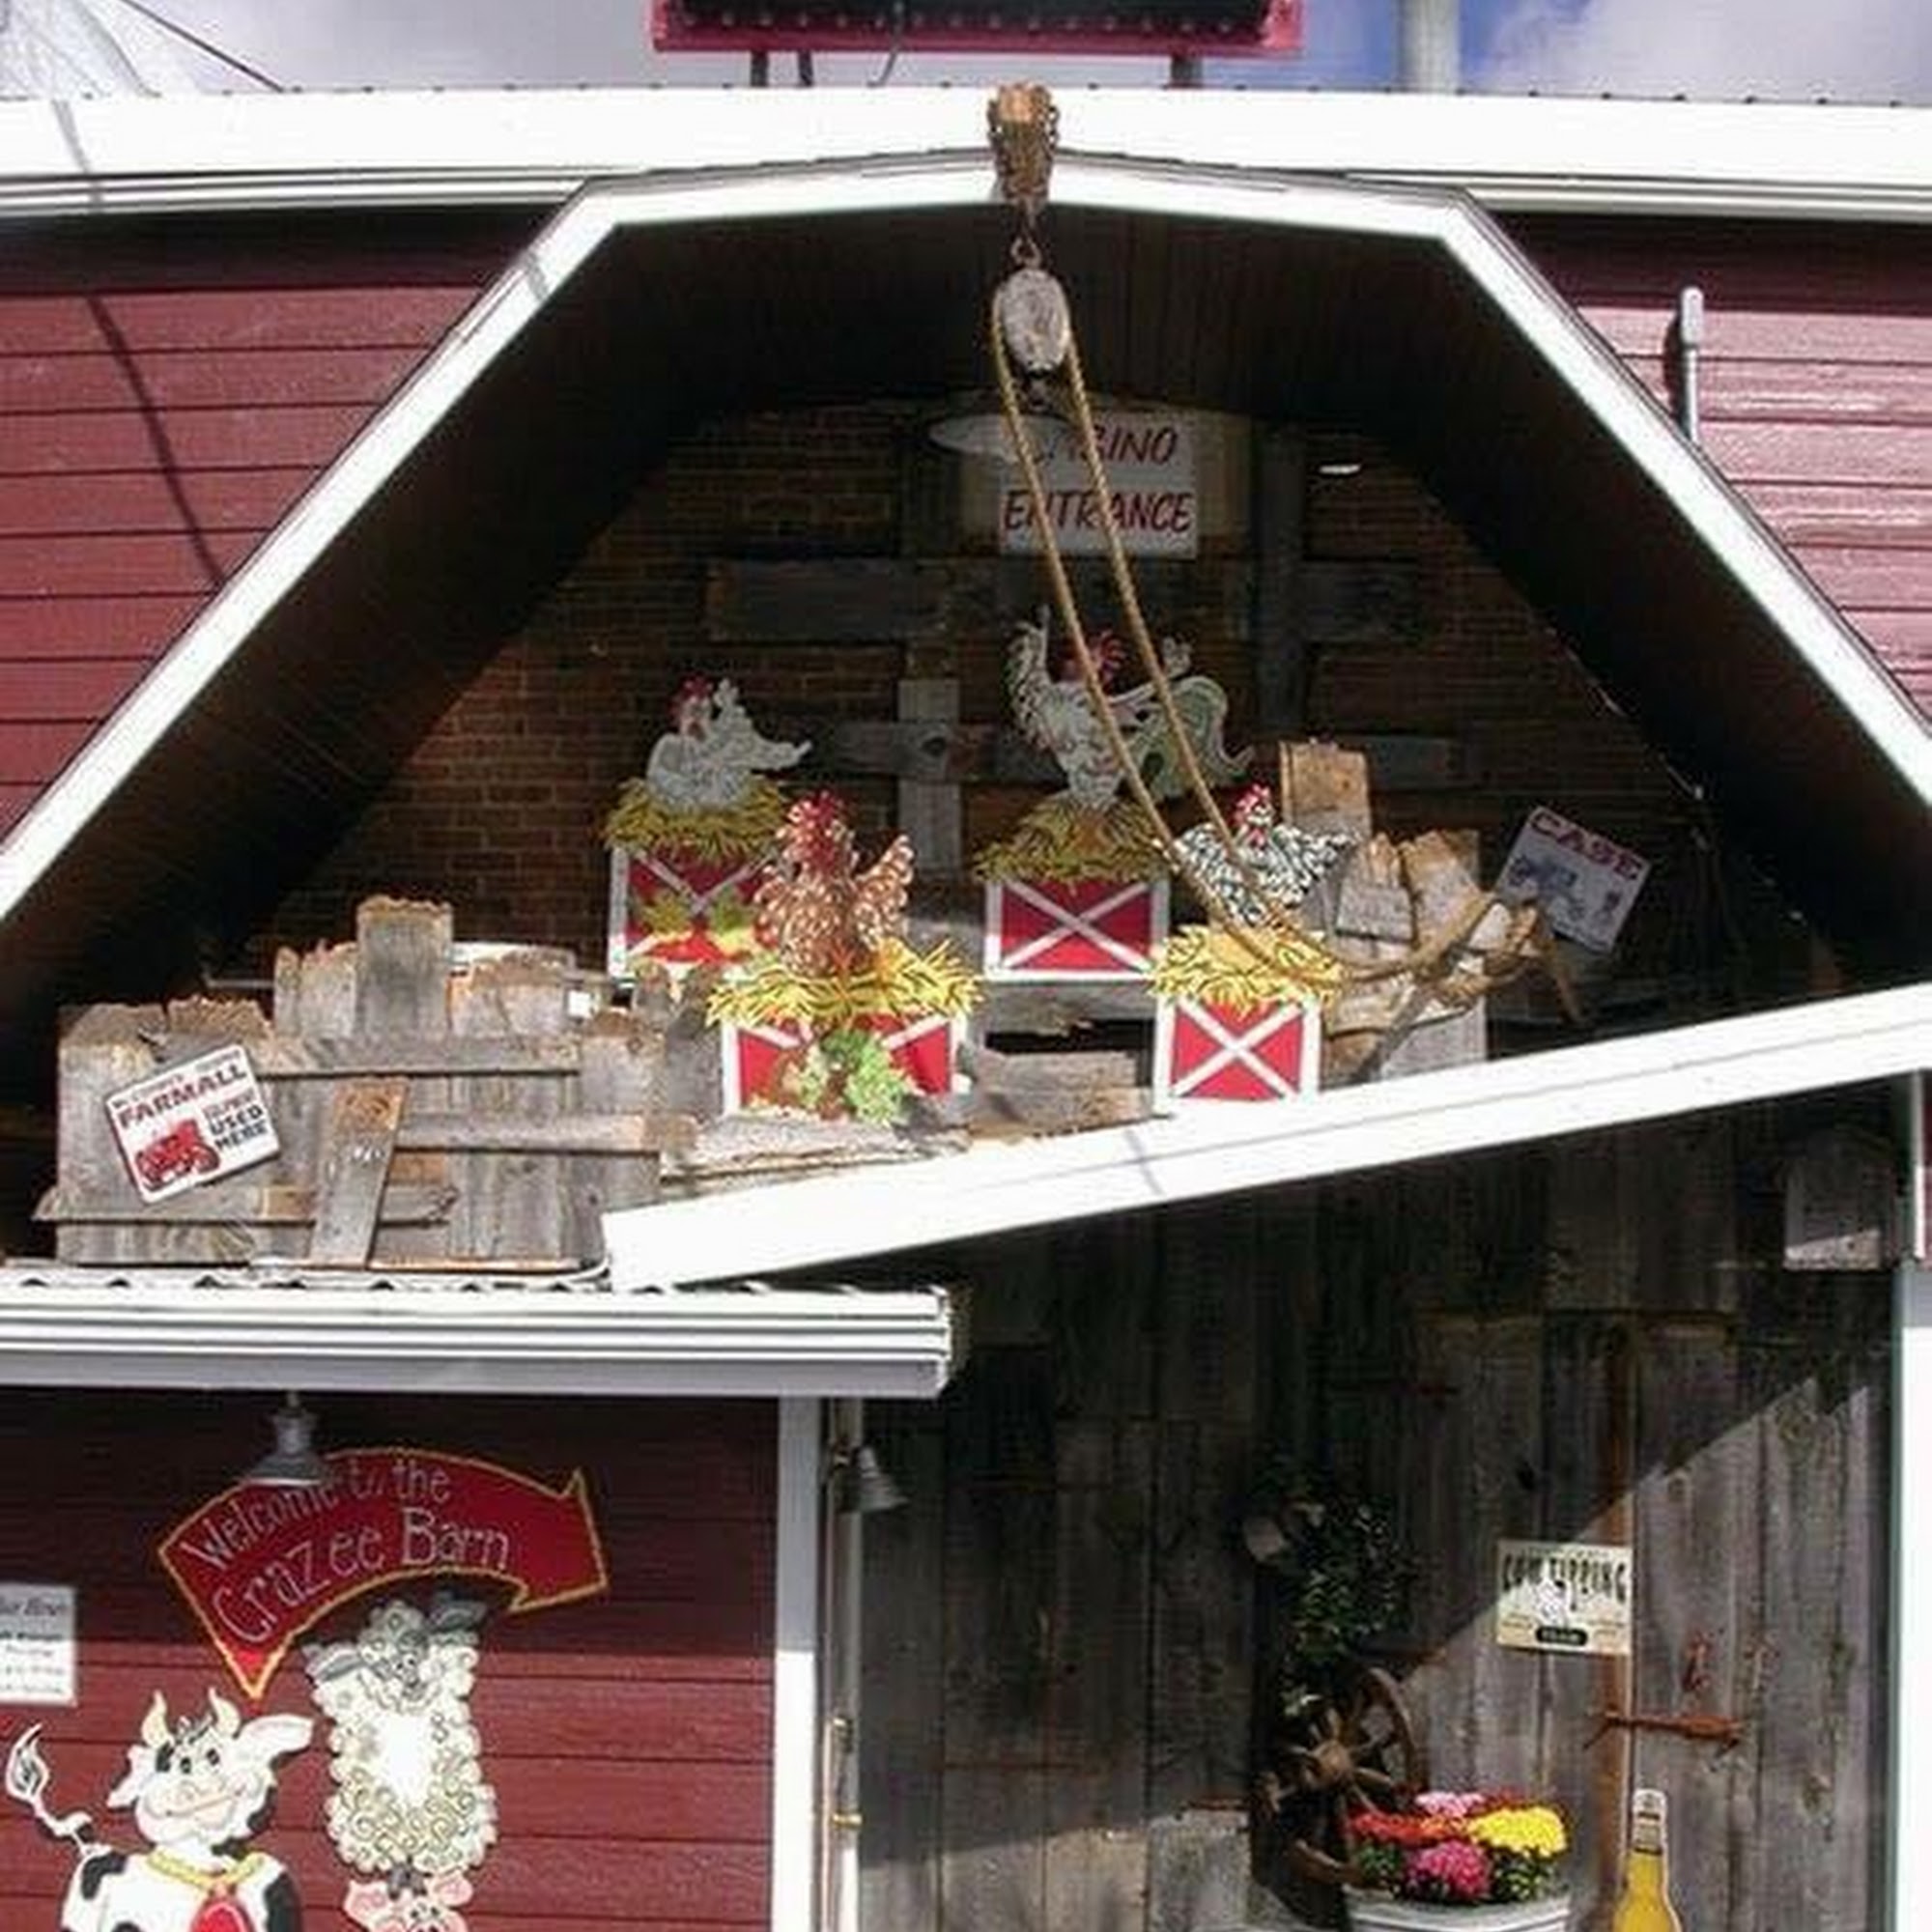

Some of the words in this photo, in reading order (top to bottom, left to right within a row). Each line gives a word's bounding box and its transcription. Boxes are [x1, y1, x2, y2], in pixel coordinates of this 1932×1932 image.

[1531, 811, 1643, 881] CASE
[117, 1064, 247, 1129] FARMALL
[210, 1104, 264, 1135] USED
[391, 1458, 451, 1504] the
[400, 1505, 510, 1572] Barn
